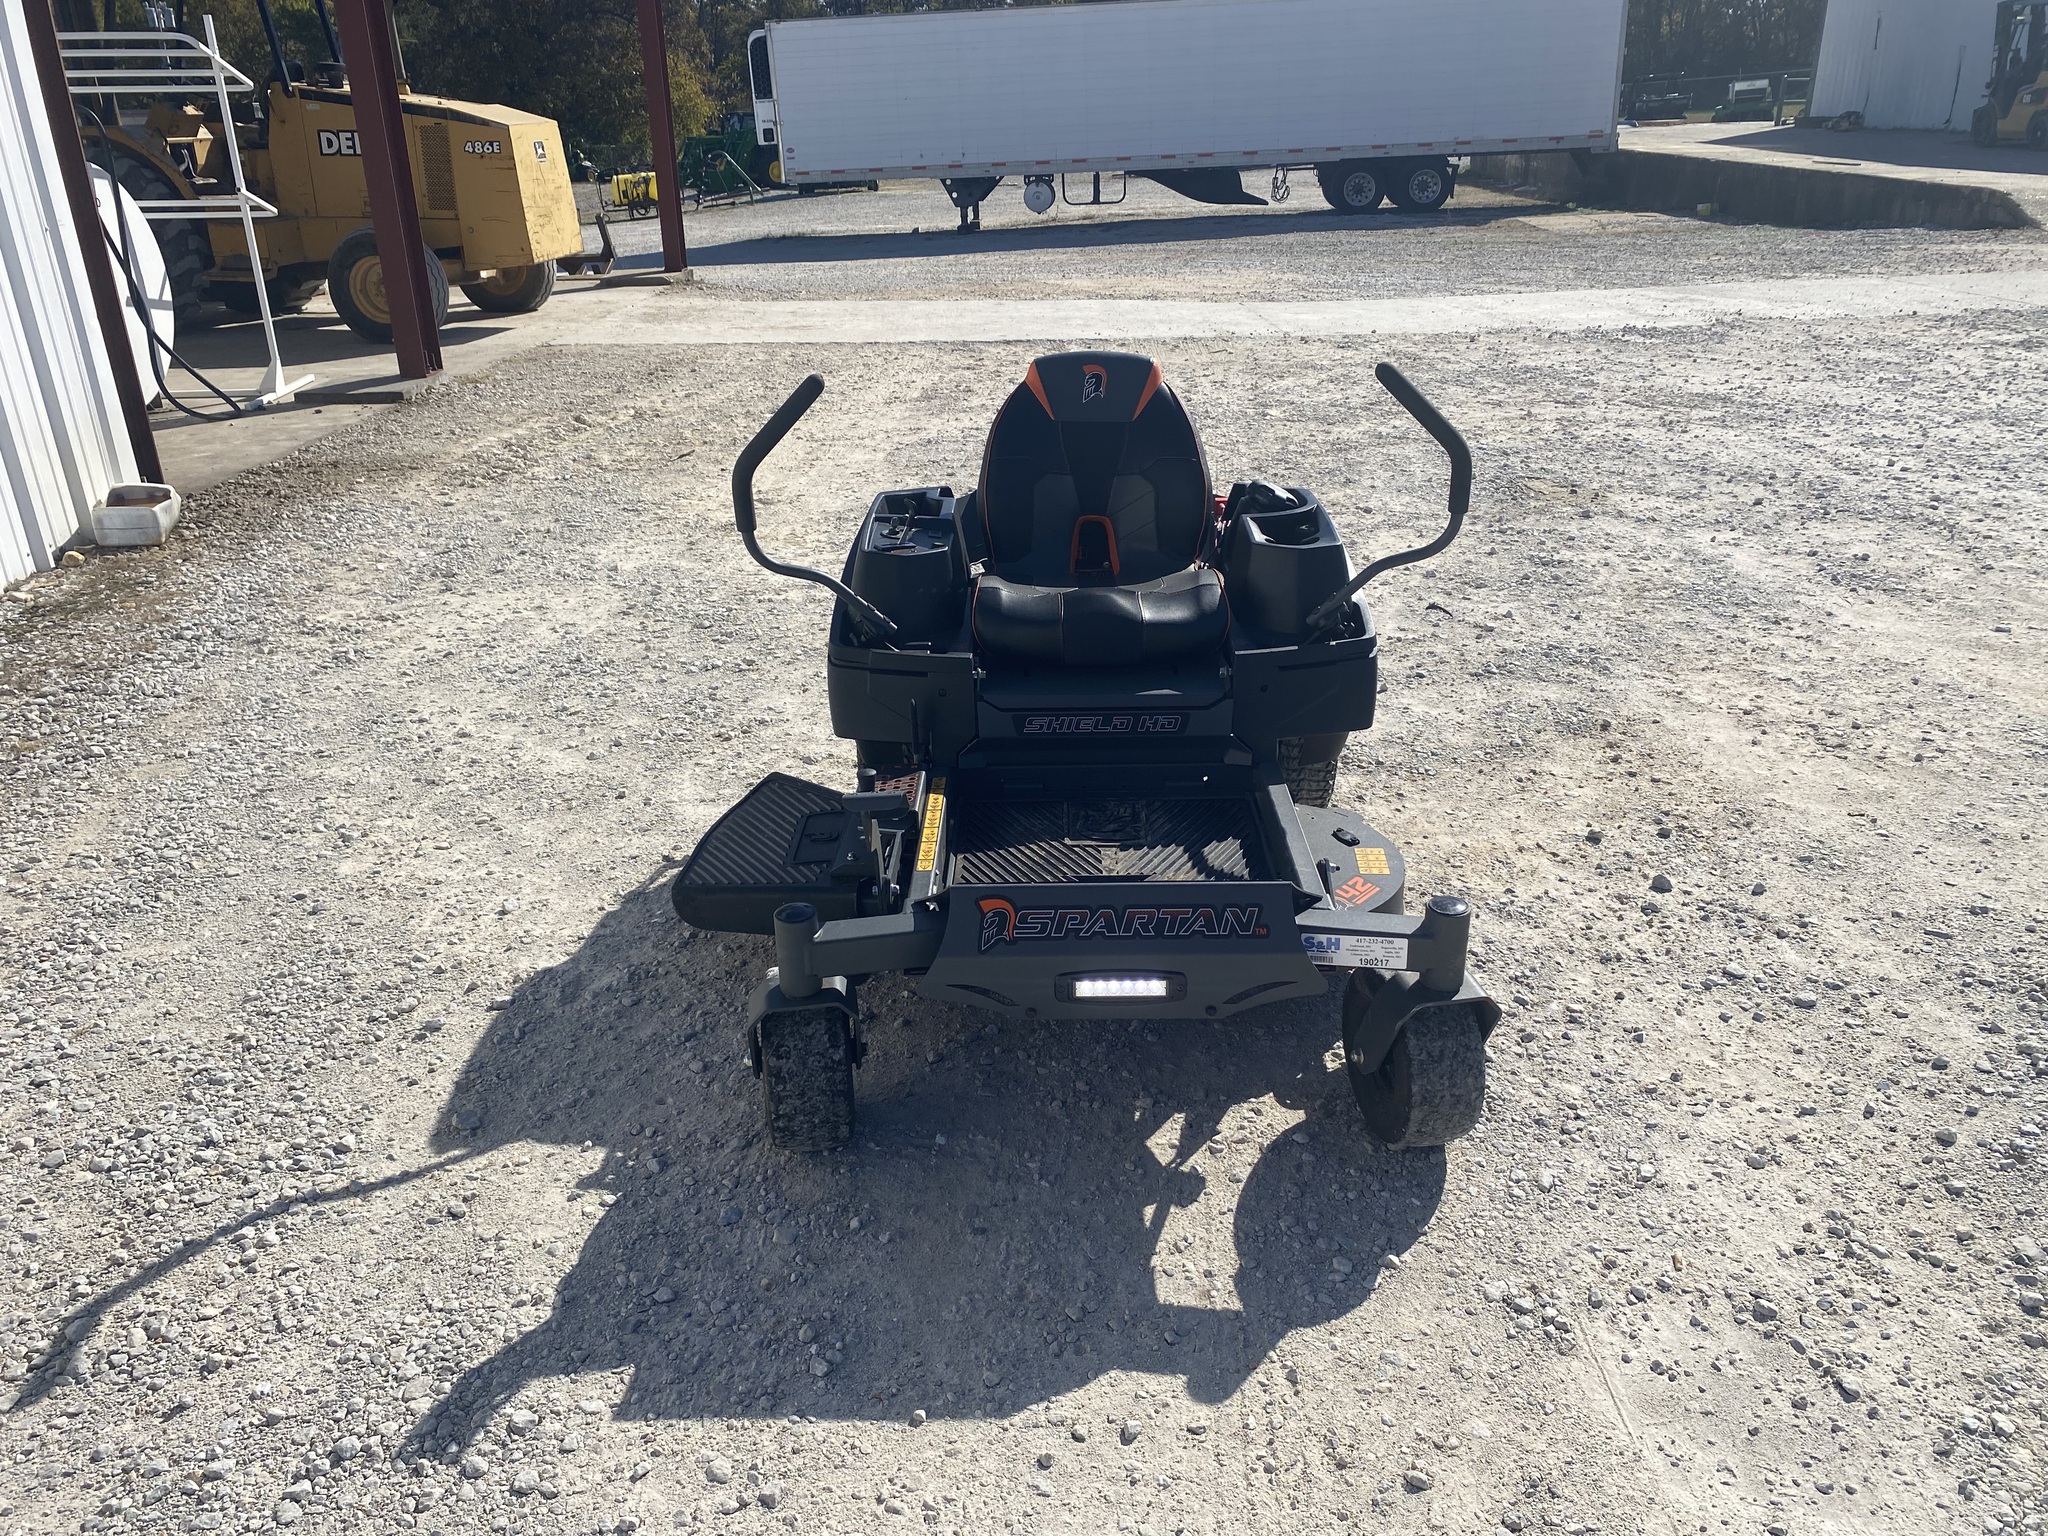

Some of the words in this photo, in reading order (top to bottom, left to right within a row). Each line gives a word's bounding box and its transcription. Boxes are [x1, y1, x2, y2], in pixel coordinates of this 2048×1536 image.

[464, 141, 501, 154] 486E
[1024, 716, 1133, 733] SHIELD
[1138, 715, 1182, 732] HD
[1336, 875, 1373, 899] 42
[1014, 907, 1259, 937] SPARTAN
[1303, 936, 1341, 951] S&H
[1359, 957, 1390, 967] 190217
